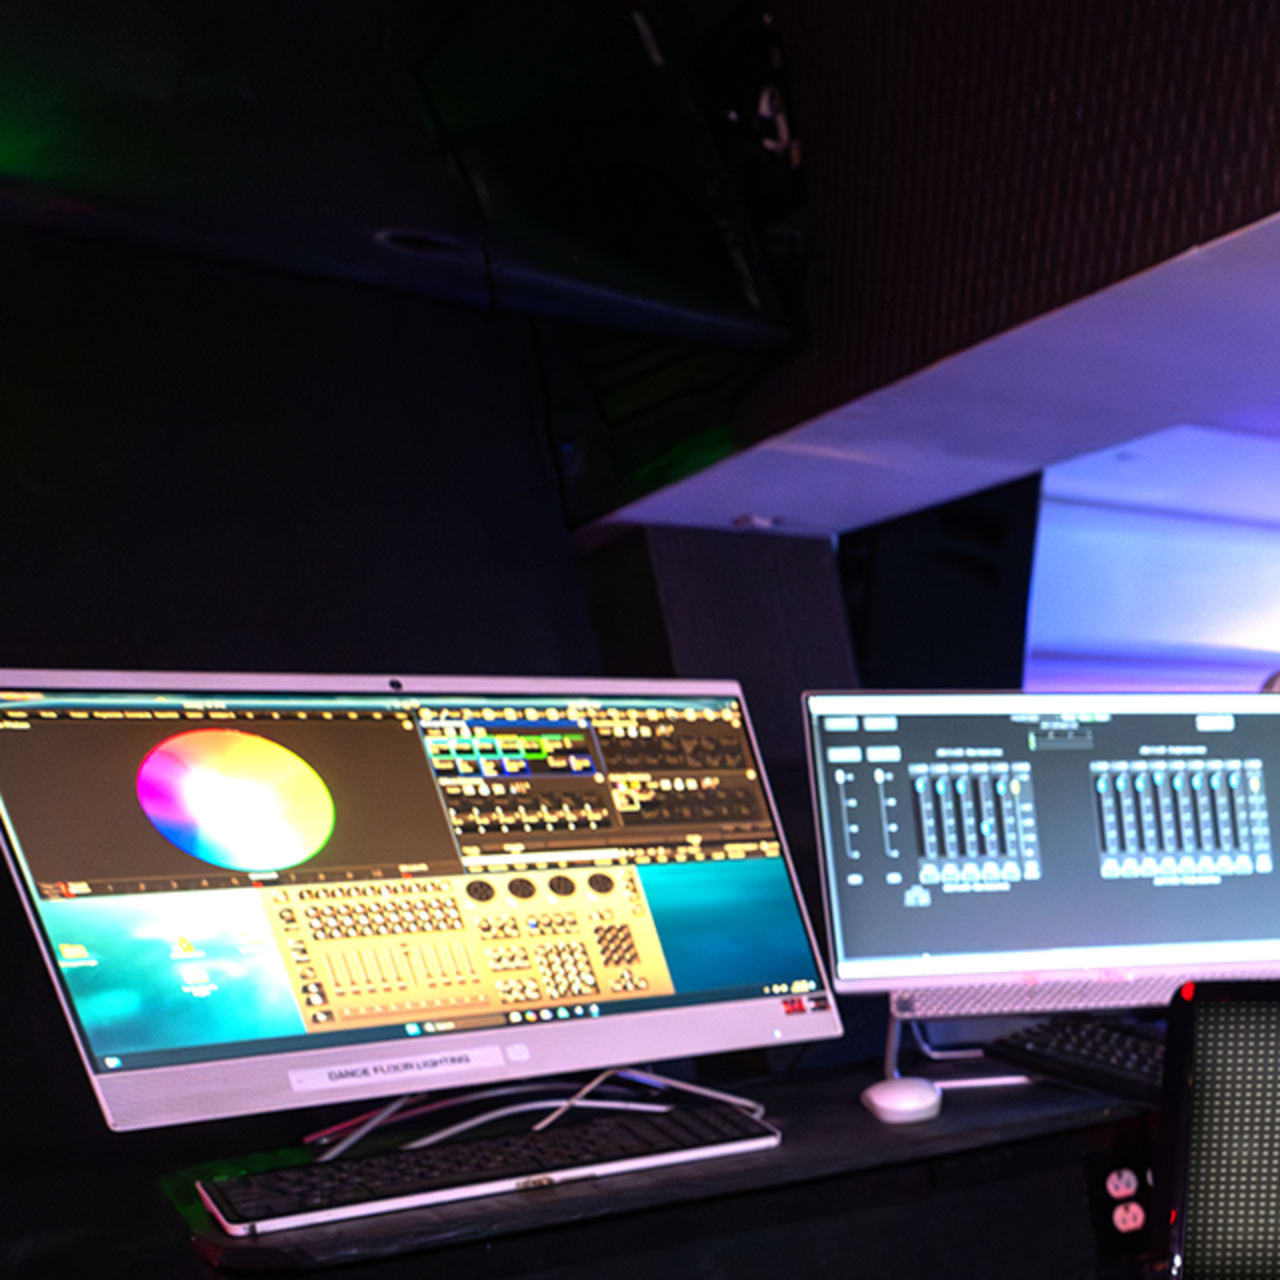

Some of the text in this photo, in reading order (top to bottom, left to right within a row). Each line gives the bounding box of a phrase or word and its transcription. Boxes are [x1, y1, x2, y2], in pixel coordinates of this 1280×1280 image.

[327, 1054, 471, 1082] DANCE FLOOR LIGHTING
